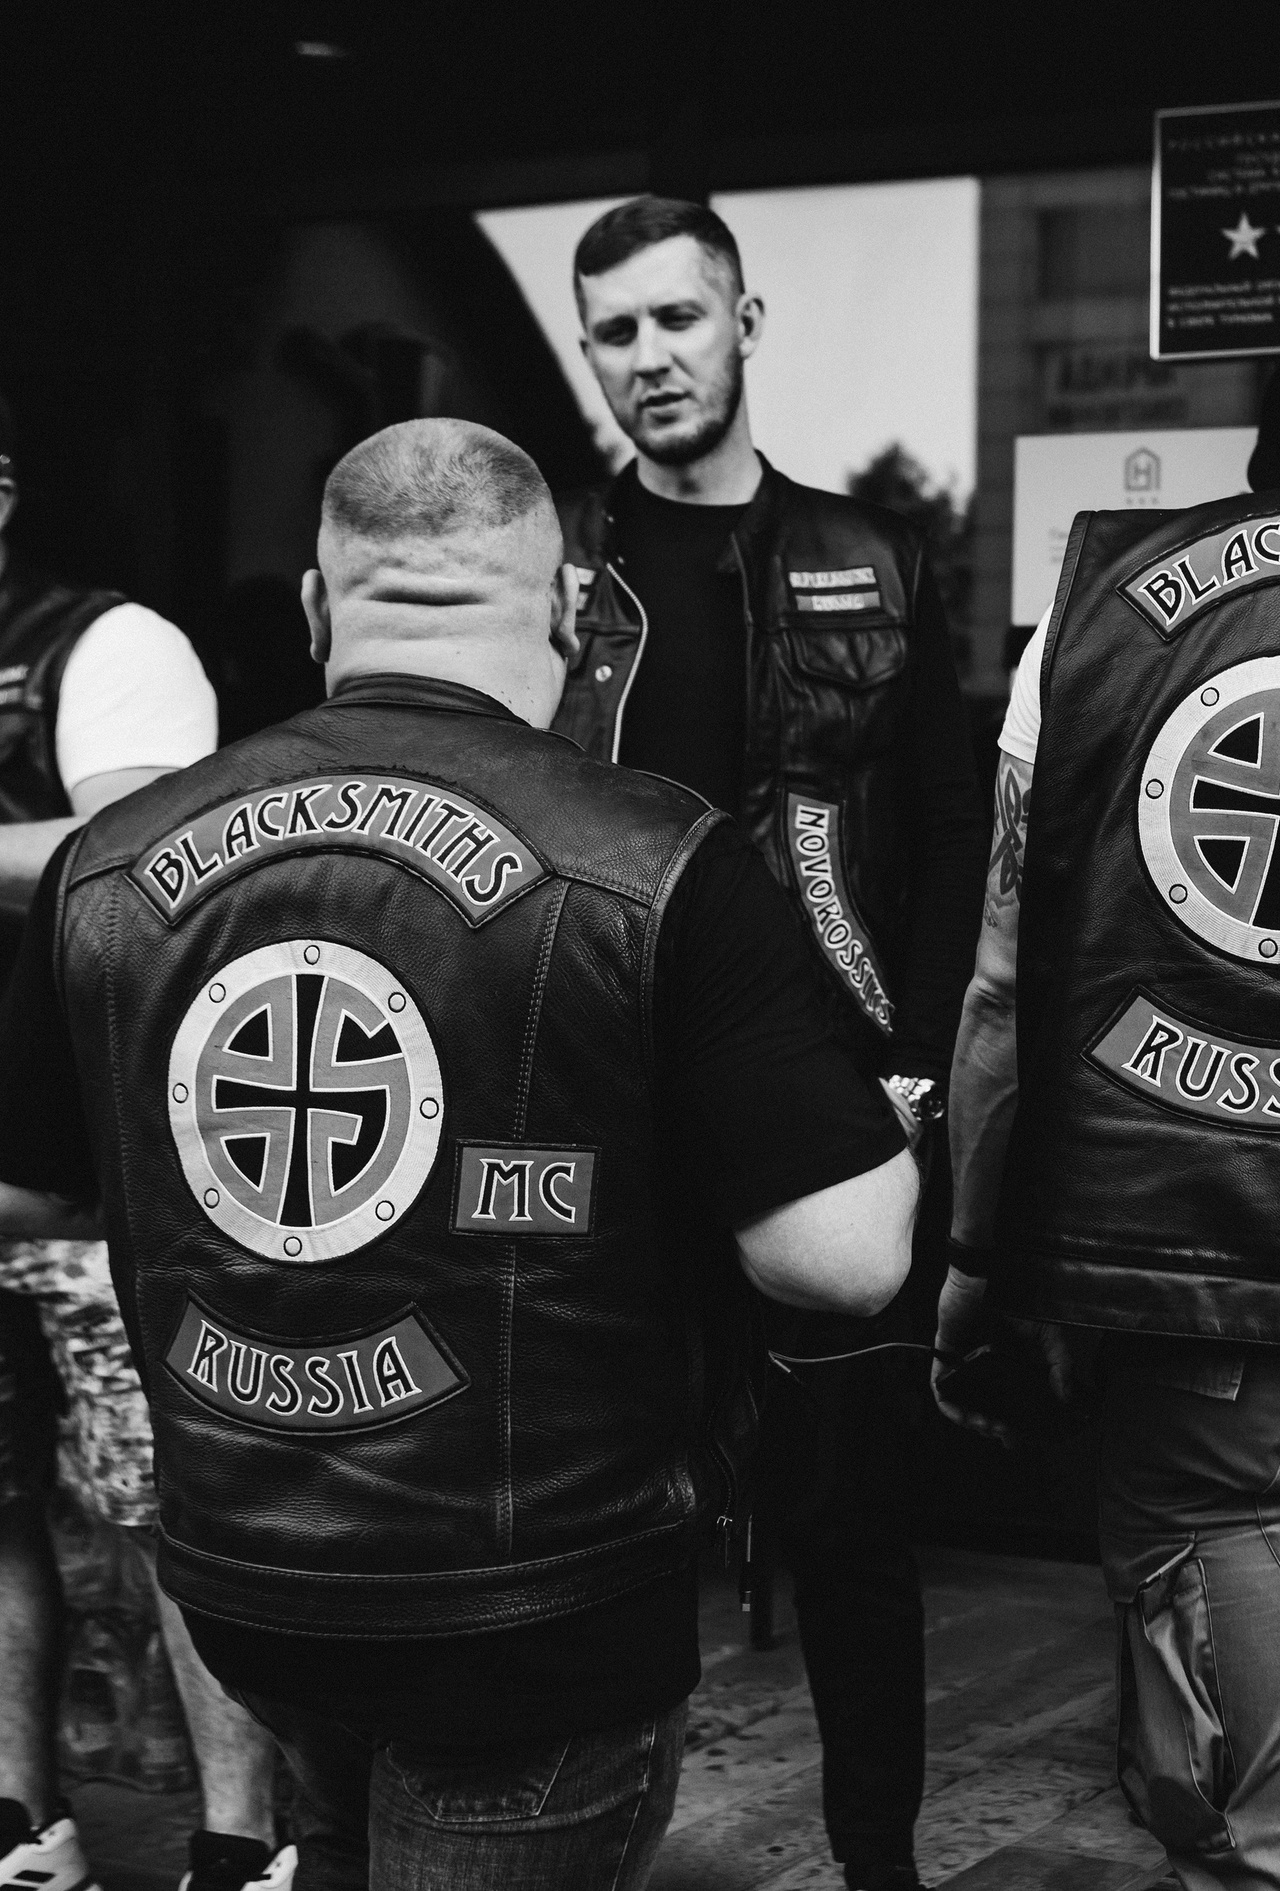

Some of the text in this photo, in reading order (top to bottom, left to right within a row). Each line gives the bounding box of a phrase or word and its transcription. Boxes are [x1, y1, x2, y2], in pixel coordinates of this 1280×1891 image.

[144, 781, 522, 909] BLACKSMITHS
[472, 1158, 576, 1223] MC
[186, 1319, 422, 1418] RUSSIA
